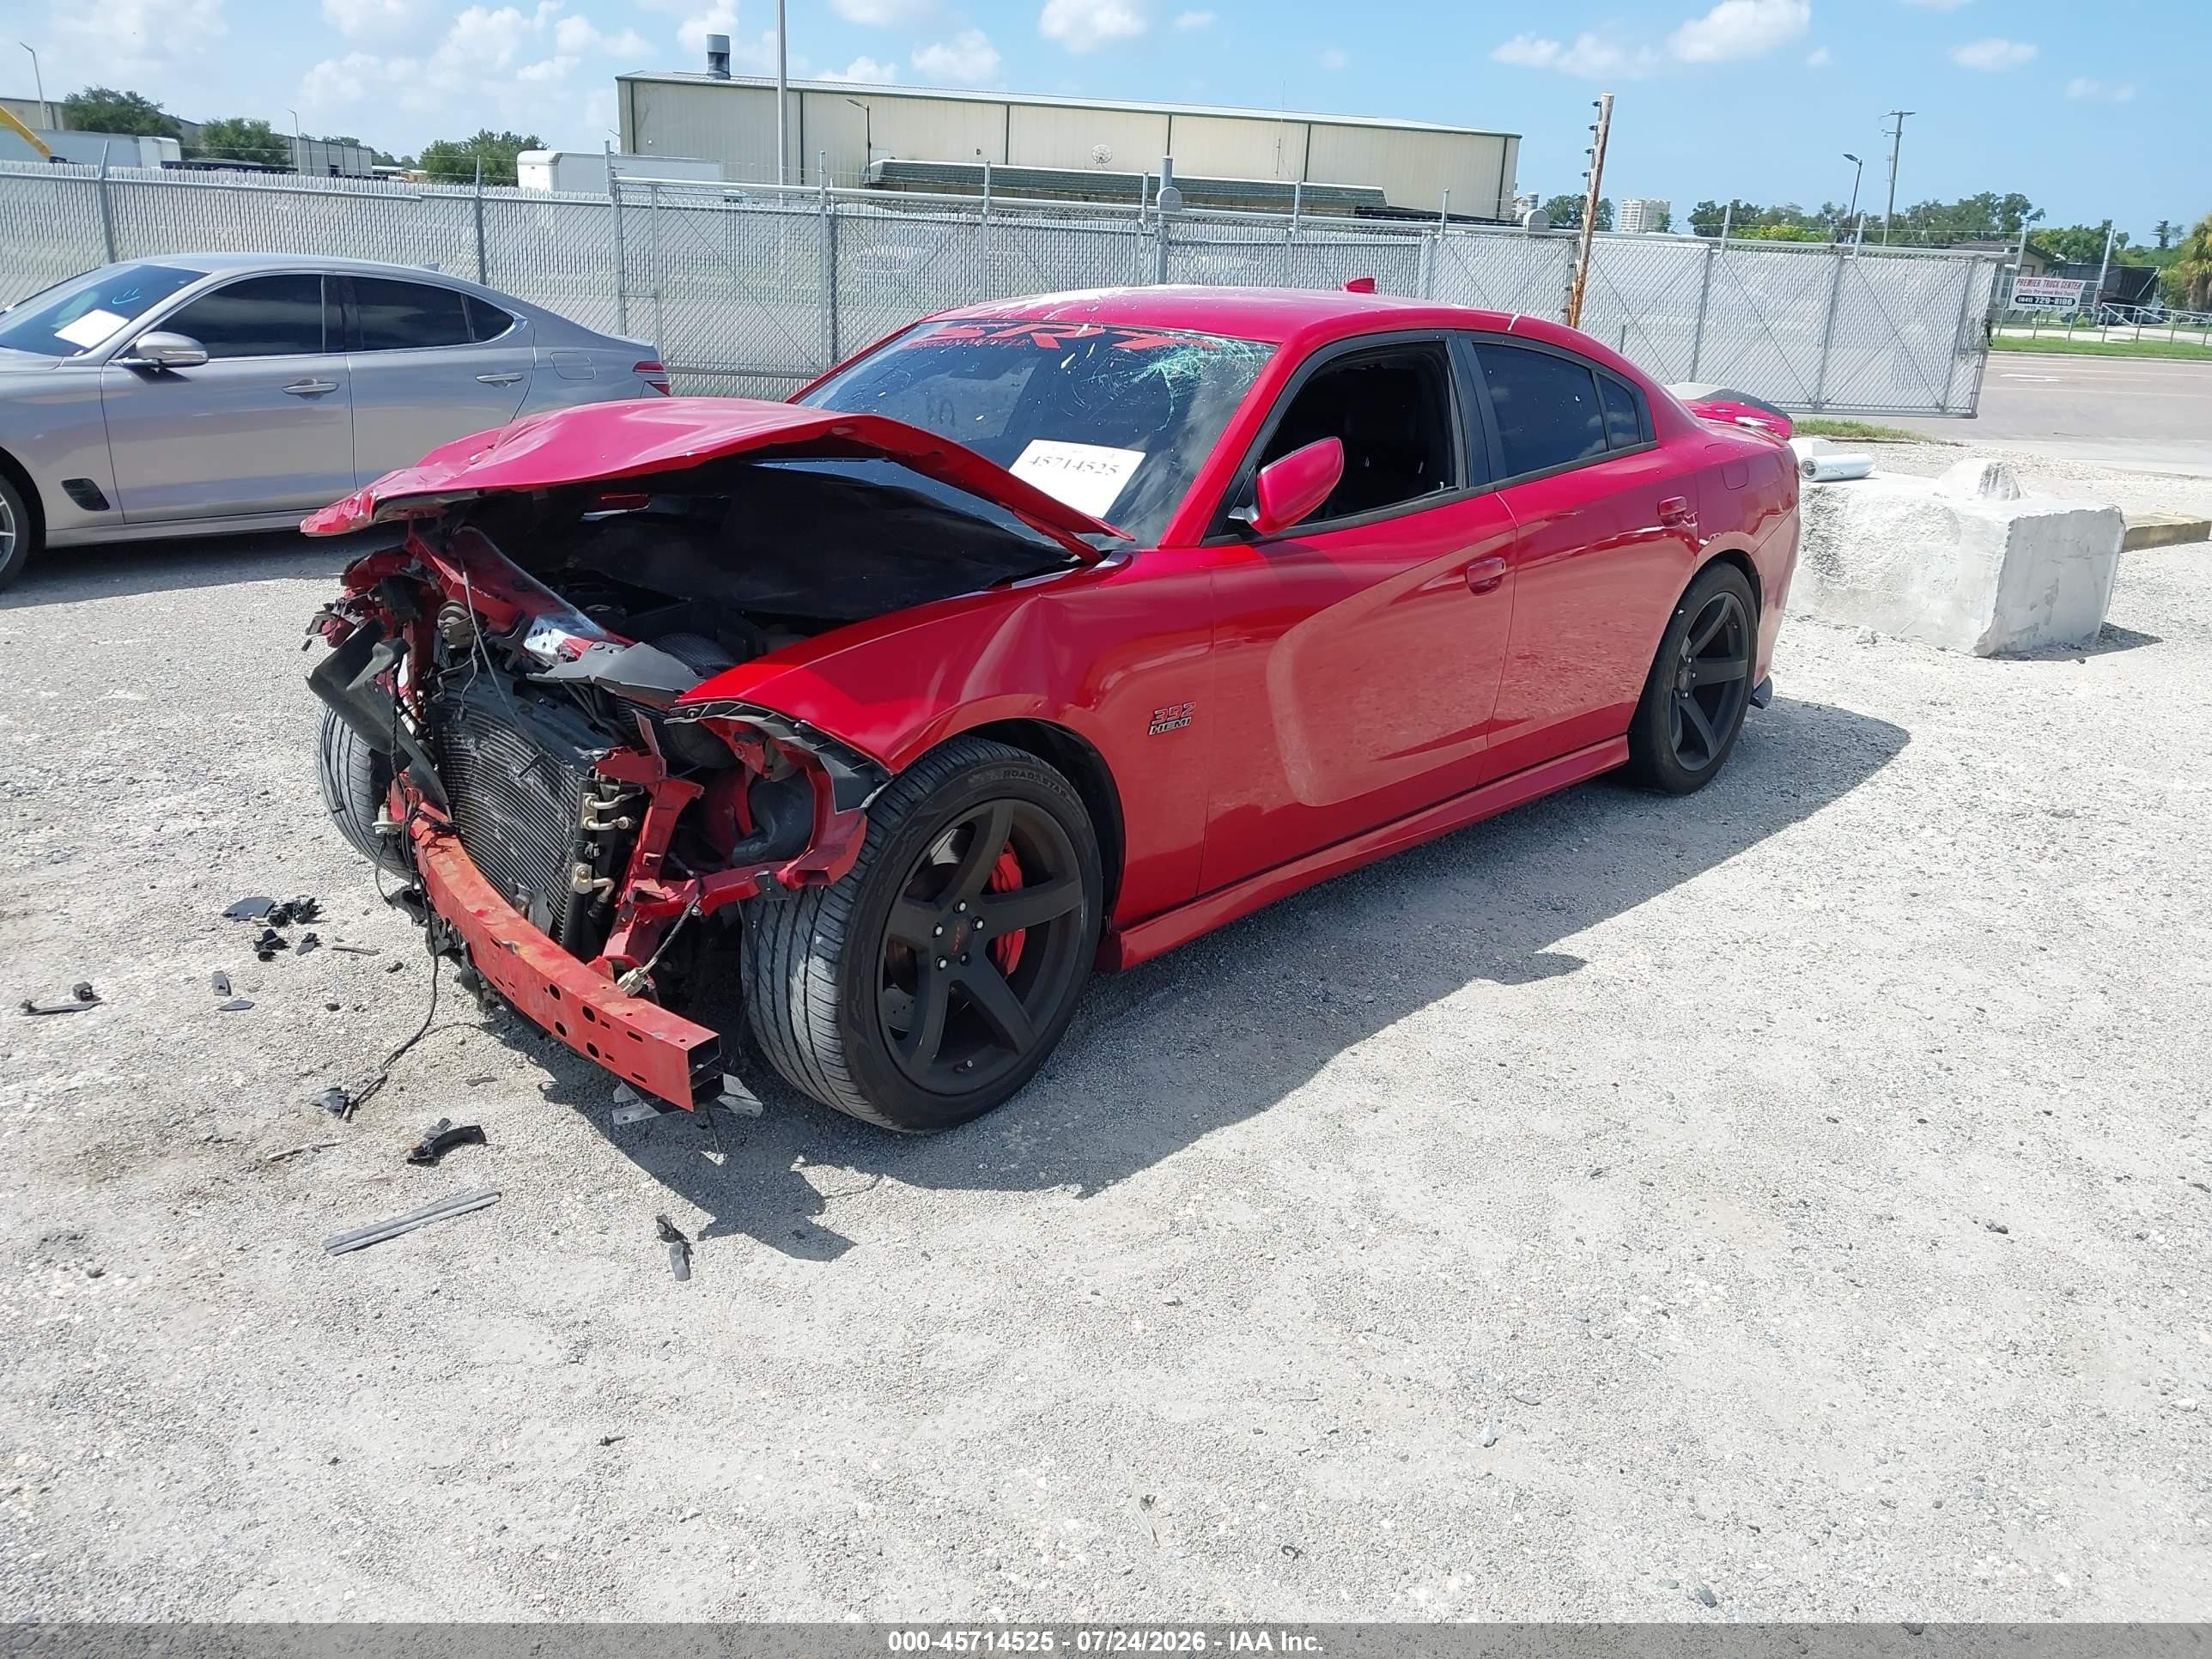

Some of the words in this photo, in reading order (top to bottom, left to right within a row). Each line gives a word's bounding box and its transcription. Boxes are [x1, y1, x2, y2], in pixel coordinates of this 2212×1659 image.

[2016, 278, 2041, 288] PREMIER
[2044, 279, 2061, 289] TRUCK
[2061, 281, 2083, 289] CENTER
[2034, 296, 2073, 306] 729-8196
[1030, 455, 1120, 476] 45714525
[1152, 702, 1196, 725] 392
[1149, 717, 1192, 736] HEMI
